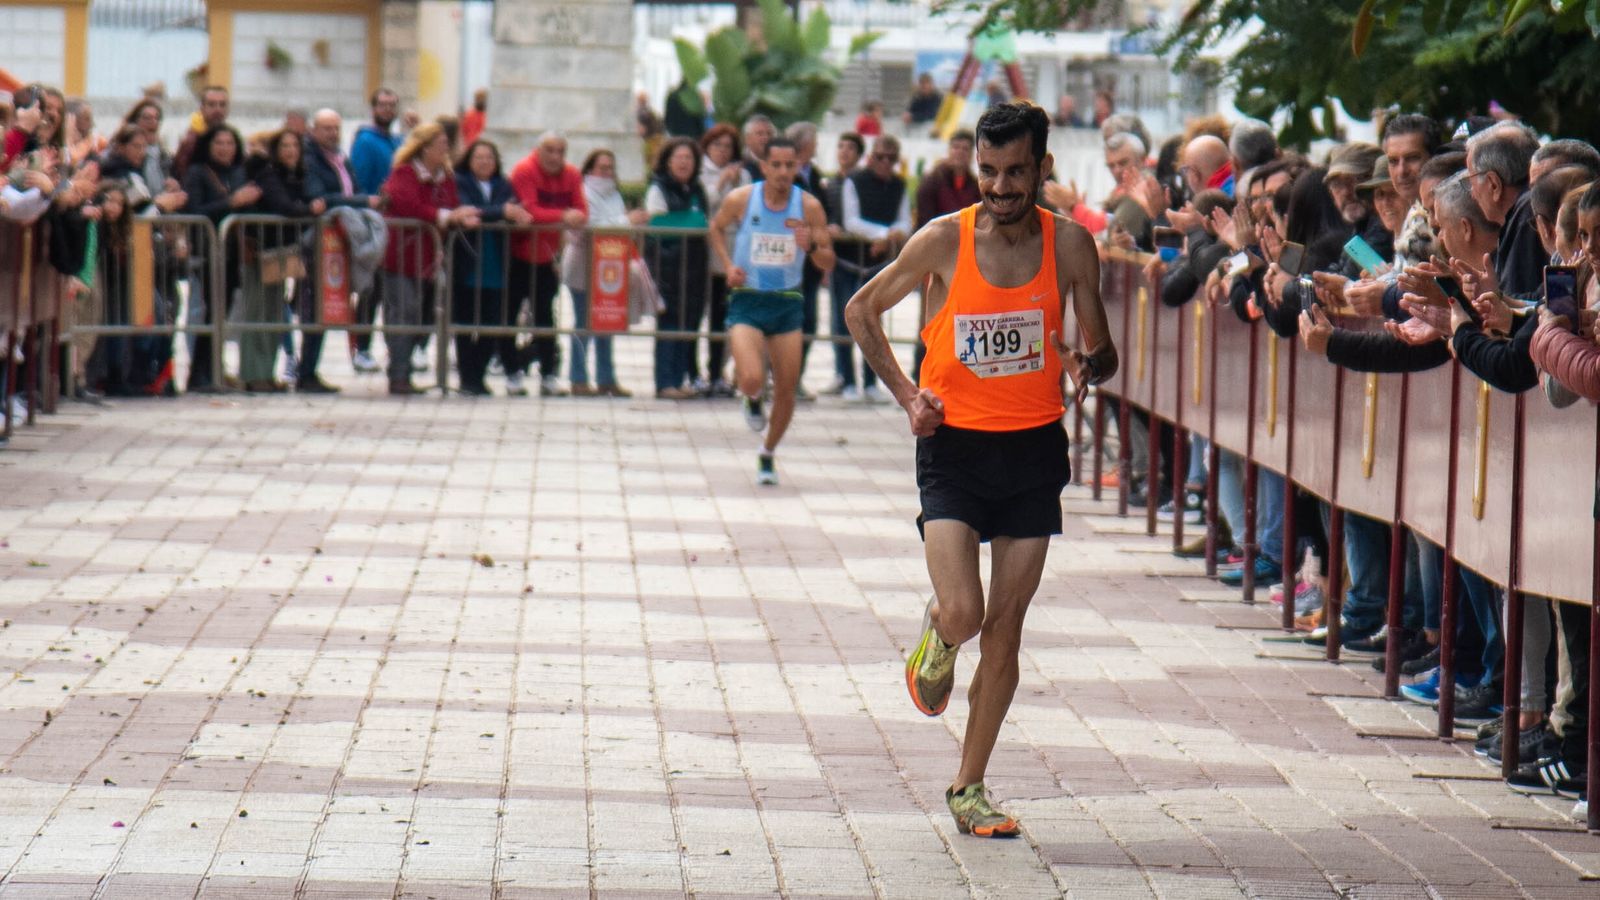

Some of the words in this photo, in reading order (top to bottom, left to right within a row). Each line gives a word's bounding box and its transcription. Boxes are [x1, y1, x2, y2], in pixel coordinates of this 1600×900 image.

[969, 319, 996, 331] XIV
[997, 316, 1025, 324] CARRERA
[1009, 320, 1040, 329] ESTRECHO
[979, 329, 1021, 357] 199
